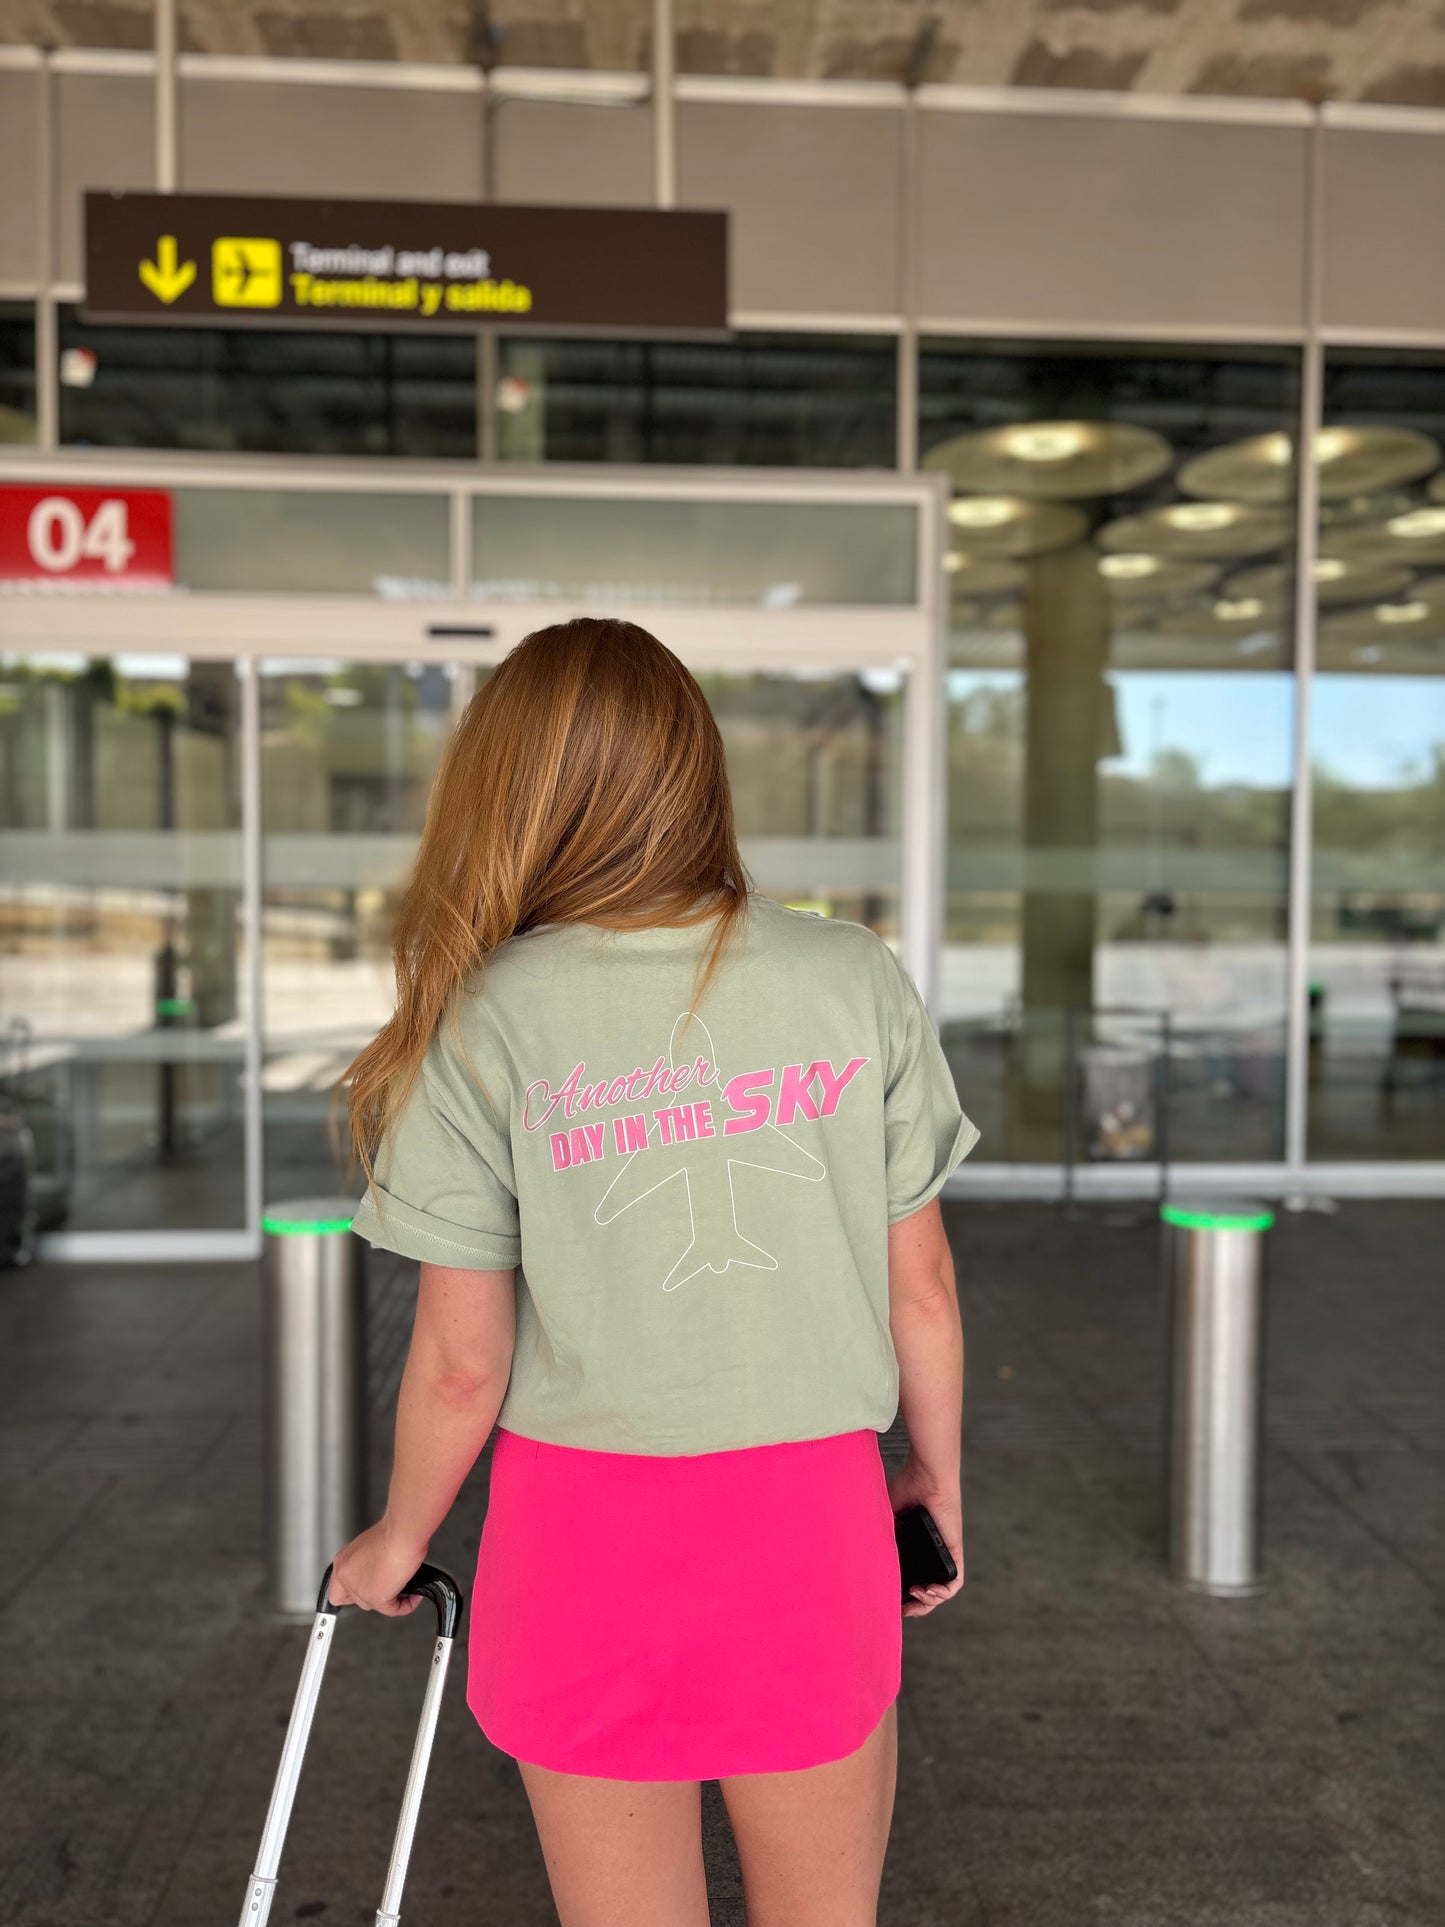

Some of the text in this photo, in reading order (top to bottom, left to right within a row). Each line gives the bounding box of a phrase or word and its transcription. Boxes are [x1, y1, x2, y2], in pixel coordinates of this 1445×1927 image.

[290, 241, 489, 278] Terminal and exit
[291, 273, 532, 315] Terminal y salida
[28, 497, 134, 573] 04
[523, 1056, 719, 1132] Another
[550, 1057, 871, 1171] DAY IN THE SKY
